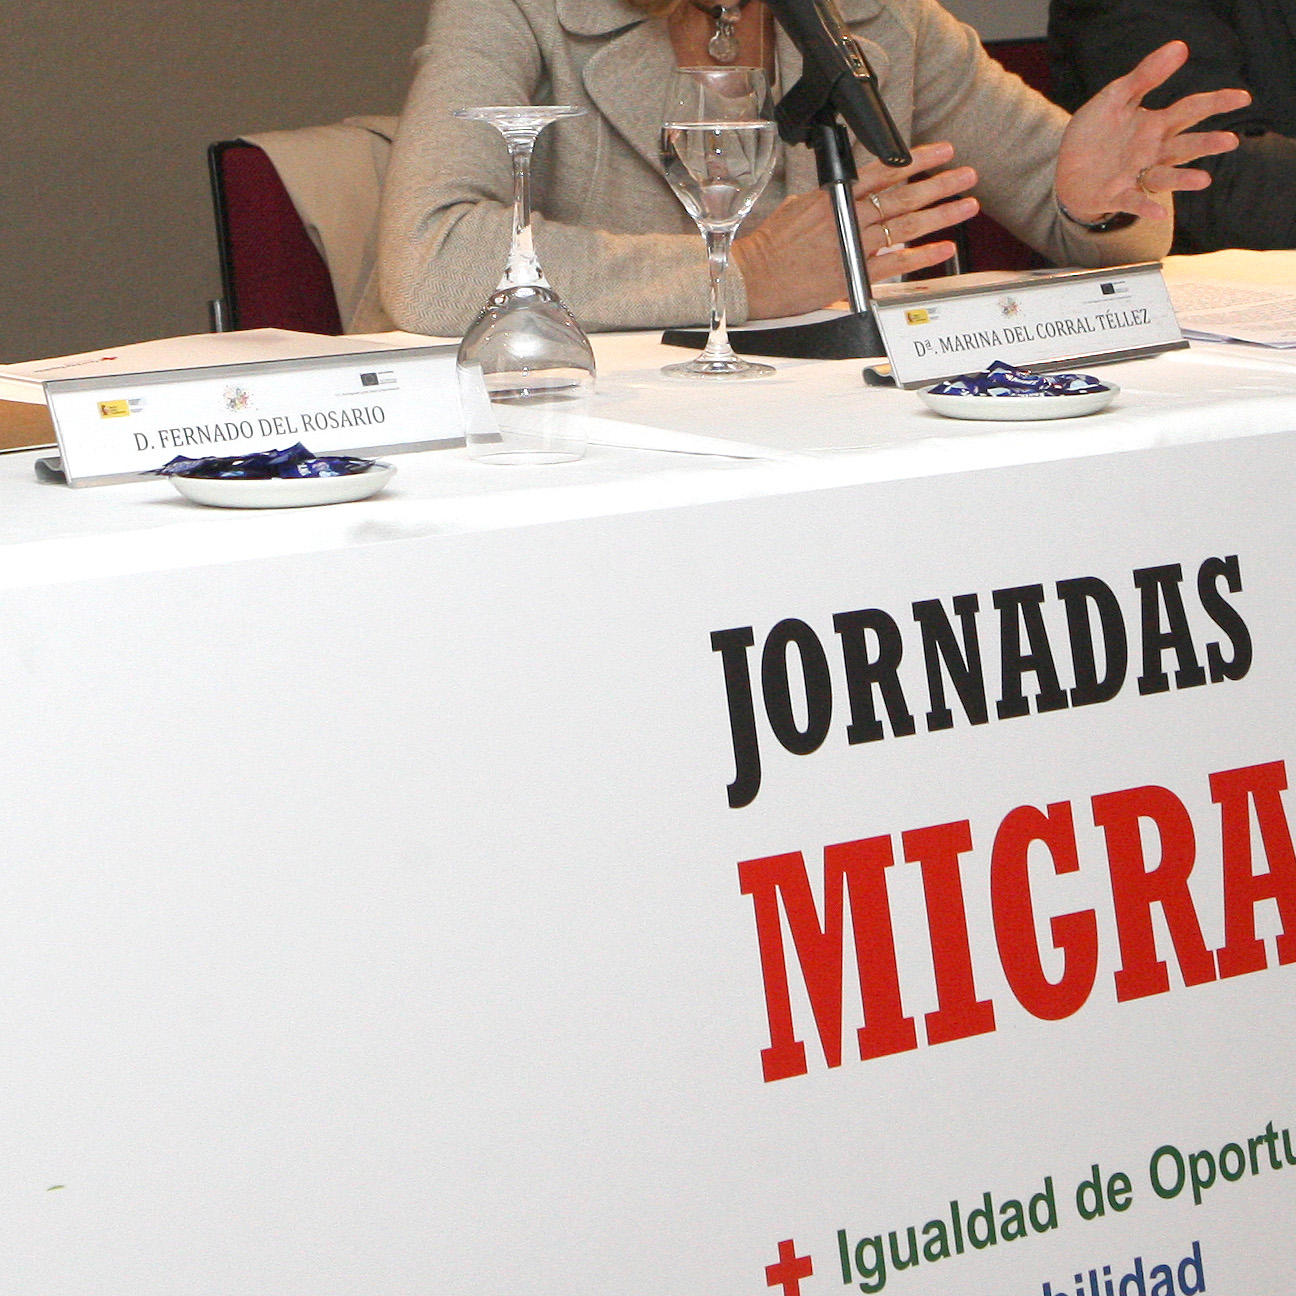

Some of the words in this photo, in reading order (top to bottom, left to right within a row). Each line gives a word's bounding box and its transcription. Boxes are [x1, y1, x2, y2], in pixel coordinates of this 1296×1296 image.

[939, 330, 1003, 354] MARINA
[1003, 325, 1035, 345] DEL
[1035, 316, 1096, 340] CORRAL
[1096, 307, 1153, 331] TÉLLEZ
[133, 432, 155, 452] D.
[158, 420, 254, 448] FERNADO
[258, 415, 298, 438] DEL
[301, 405, 386, 432] ROSARIO
[710, 555, 1253, 809] JORNADAS
[837, 1175, 1059, 1294] Igualdad
[1075, 1164, 1133, 1221] de
